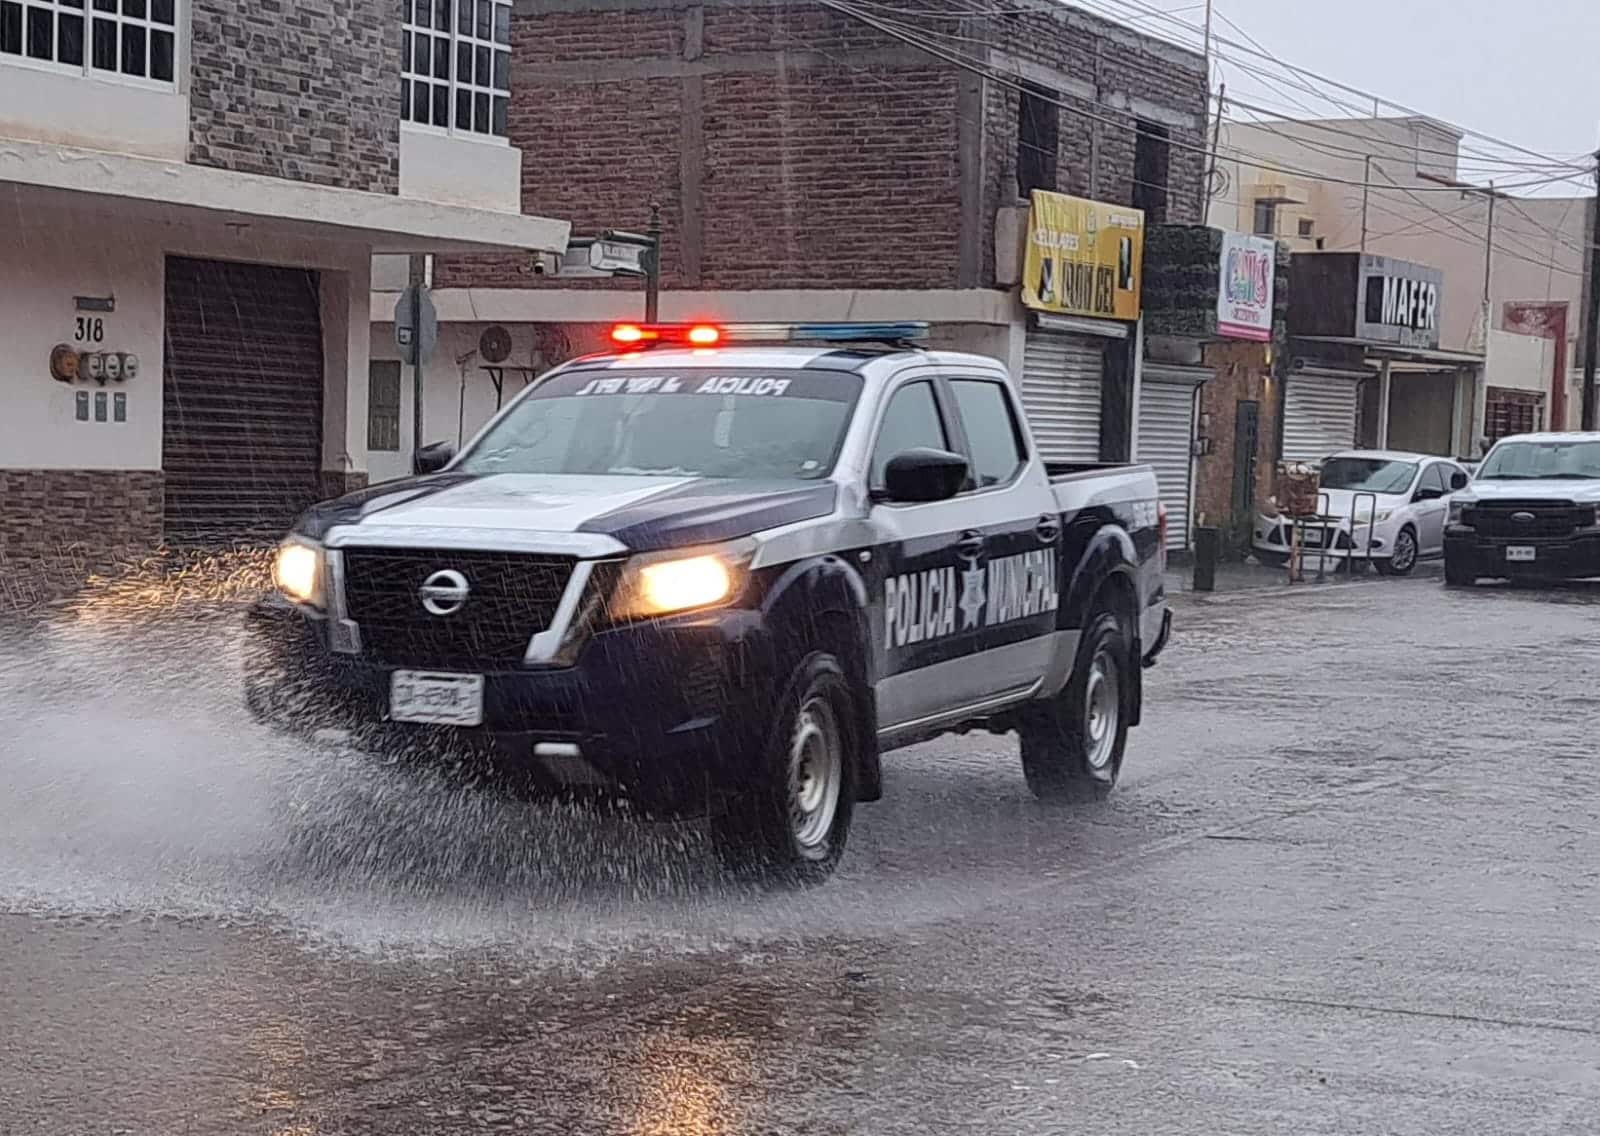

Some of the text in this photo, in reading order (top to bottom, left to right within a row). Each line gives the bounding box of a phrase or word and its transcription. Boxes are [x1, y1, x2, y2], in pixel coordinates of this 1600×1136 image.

[1381, 276, 1436, 329] MAFER
[75, 317, 104, 342] 318
[884, 566, 956, 651] POLICIA
